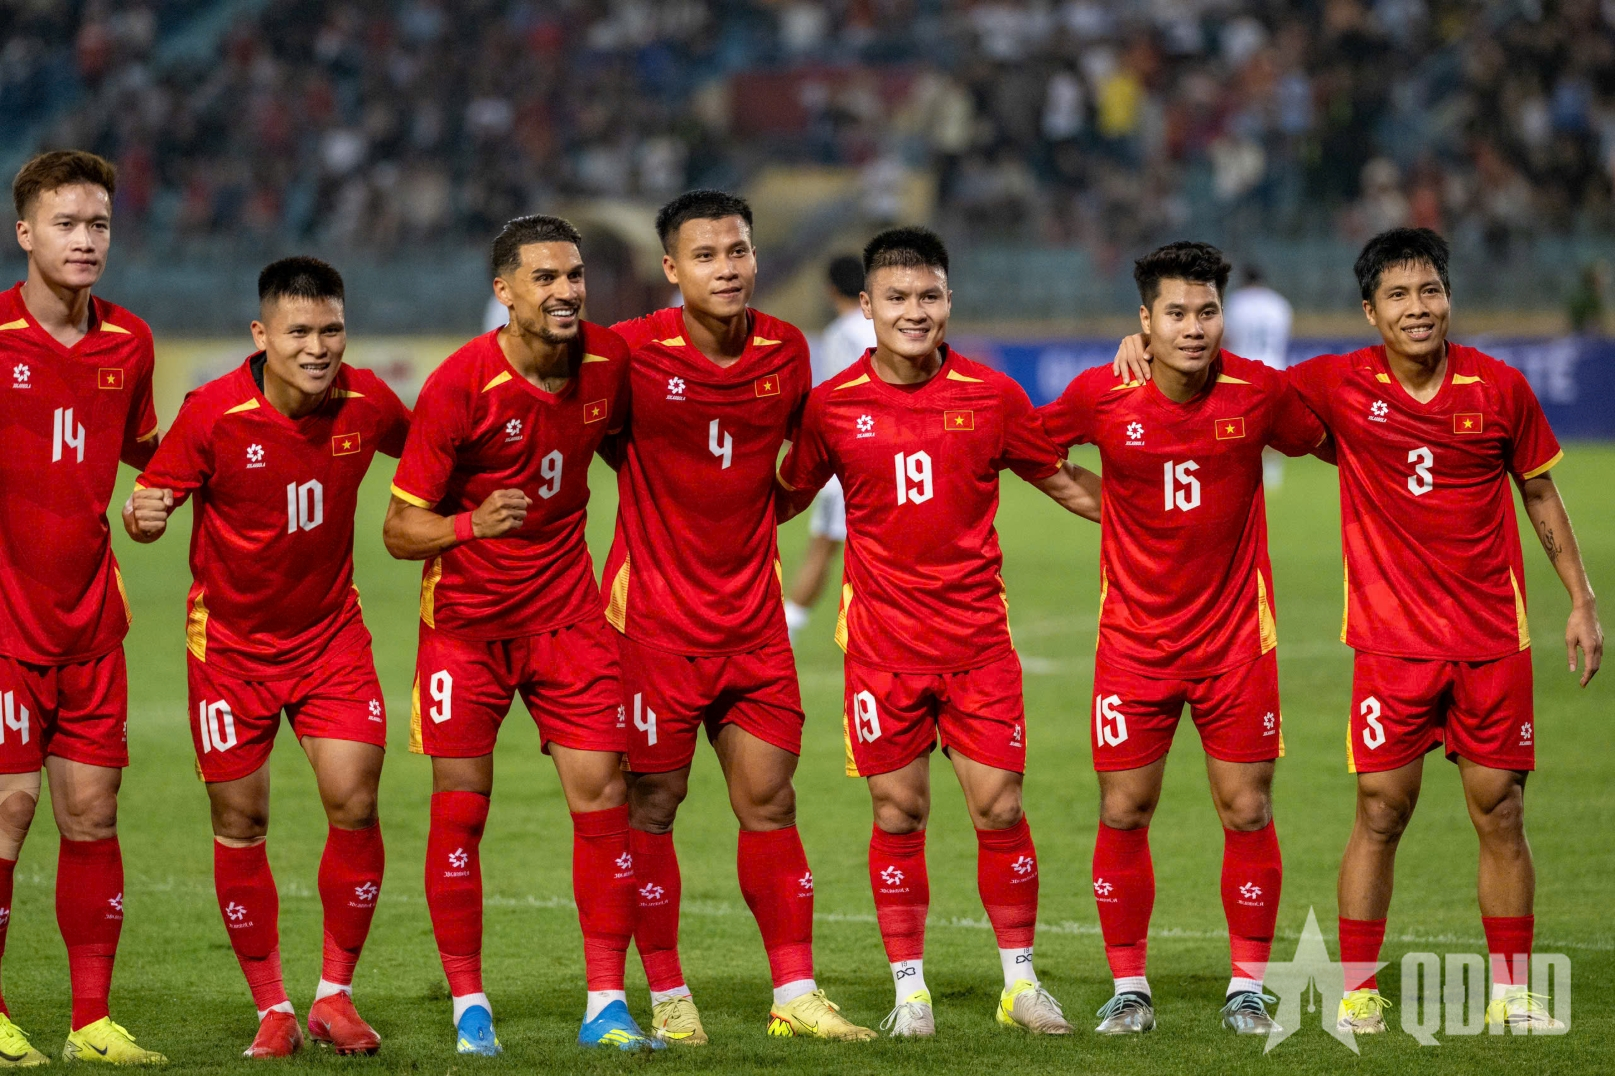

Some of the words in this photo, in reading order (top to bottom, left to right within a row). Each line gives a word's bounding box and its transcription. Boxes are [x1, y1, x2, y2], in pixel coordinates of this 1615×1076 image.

[51, 407, 86, 463] 14
[708, 418, 733, 469] 4
[538, 449, 563, 499] 9
[894, 450, 934, 506] 19
[1163, 459, 1201, 512] 15
[1407, 446, 1434, 496] 3
[286, 479, 324, 534] 10
[429, 669, 453, 724] 9
[633, 693, 657, 746] 4
[852, 690, 882, 743] 19
[1096, 694, 1129, 747] 15
[1360, 696, 1386, 750] 3
[199, 699, 238, 754] 10
